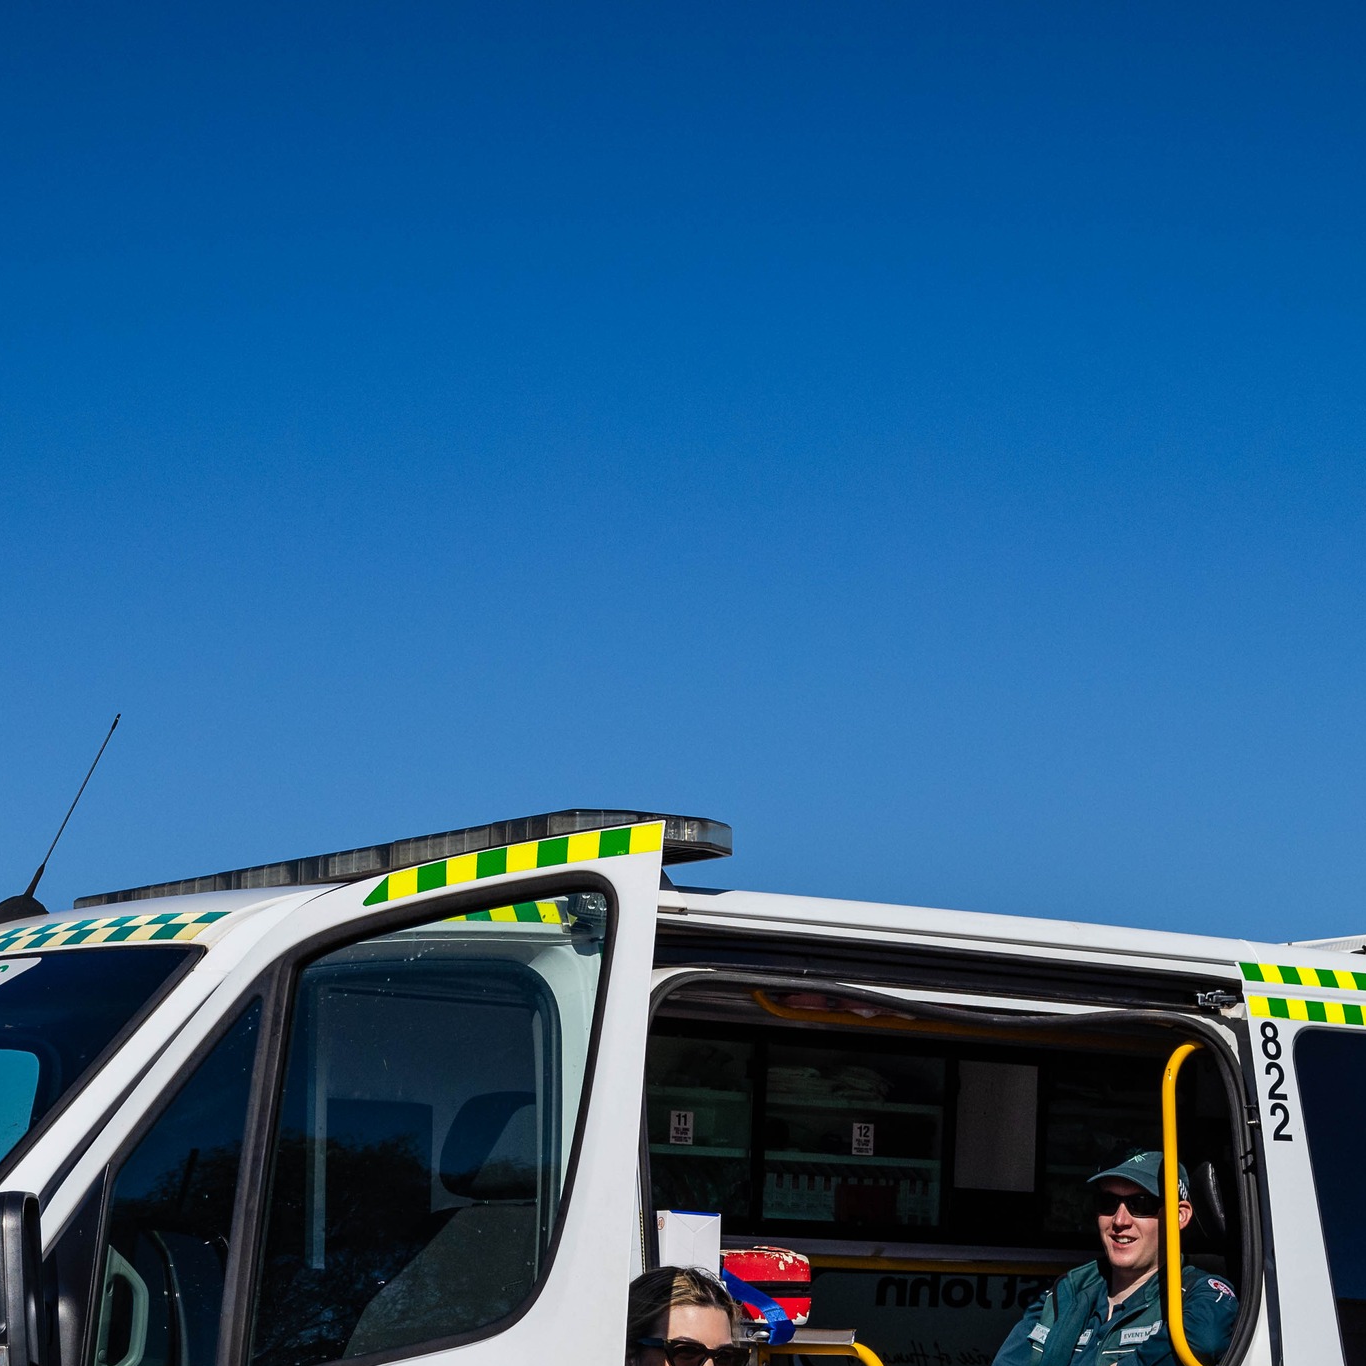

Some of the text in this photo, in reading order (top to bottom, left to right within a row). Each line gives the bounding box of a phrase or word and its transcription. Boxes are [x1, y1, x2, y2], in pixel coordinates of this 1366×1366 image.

[1260, 1021, 1293, 1142] 822
[675, 1112, 688, 1127] 11
[857, 1124, 870, 1138] 12
